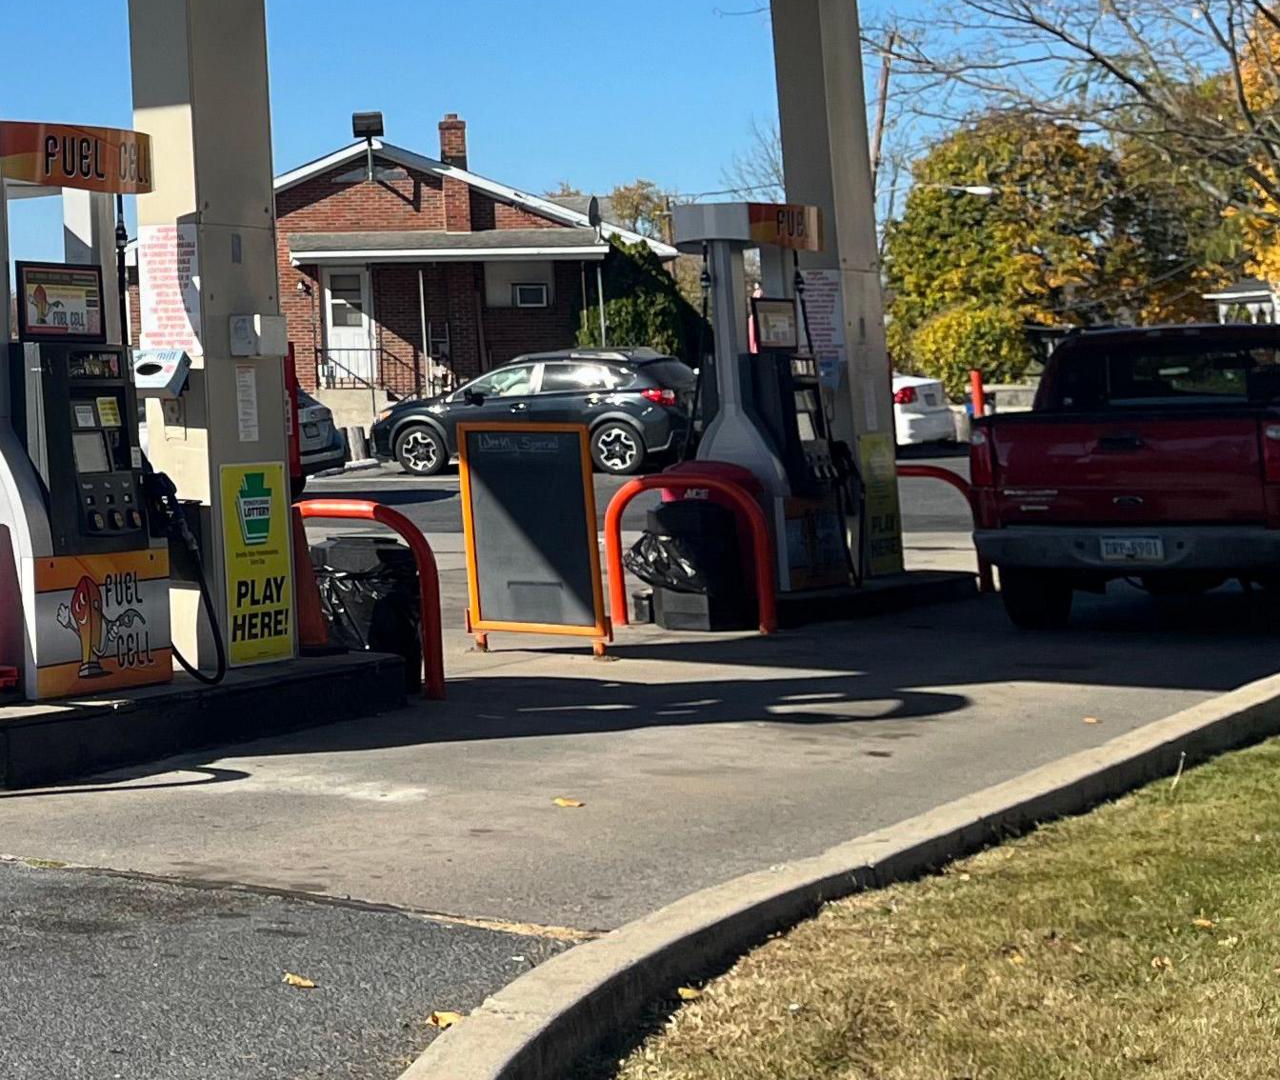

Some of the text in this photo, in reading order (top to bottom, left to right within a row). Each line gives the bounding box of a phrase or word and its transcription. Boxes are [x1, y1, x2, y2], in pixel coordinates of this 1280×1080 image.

[44, 135, 106, 183] FUEL
[244, 507, 270, 518] LOTTERY
[105, 572, 143, 608] FUEL
[237, 576, 286, 608] PLAY
[232, 608, 289, 642] HERE!
[117, 631, 155, 668] CELL
